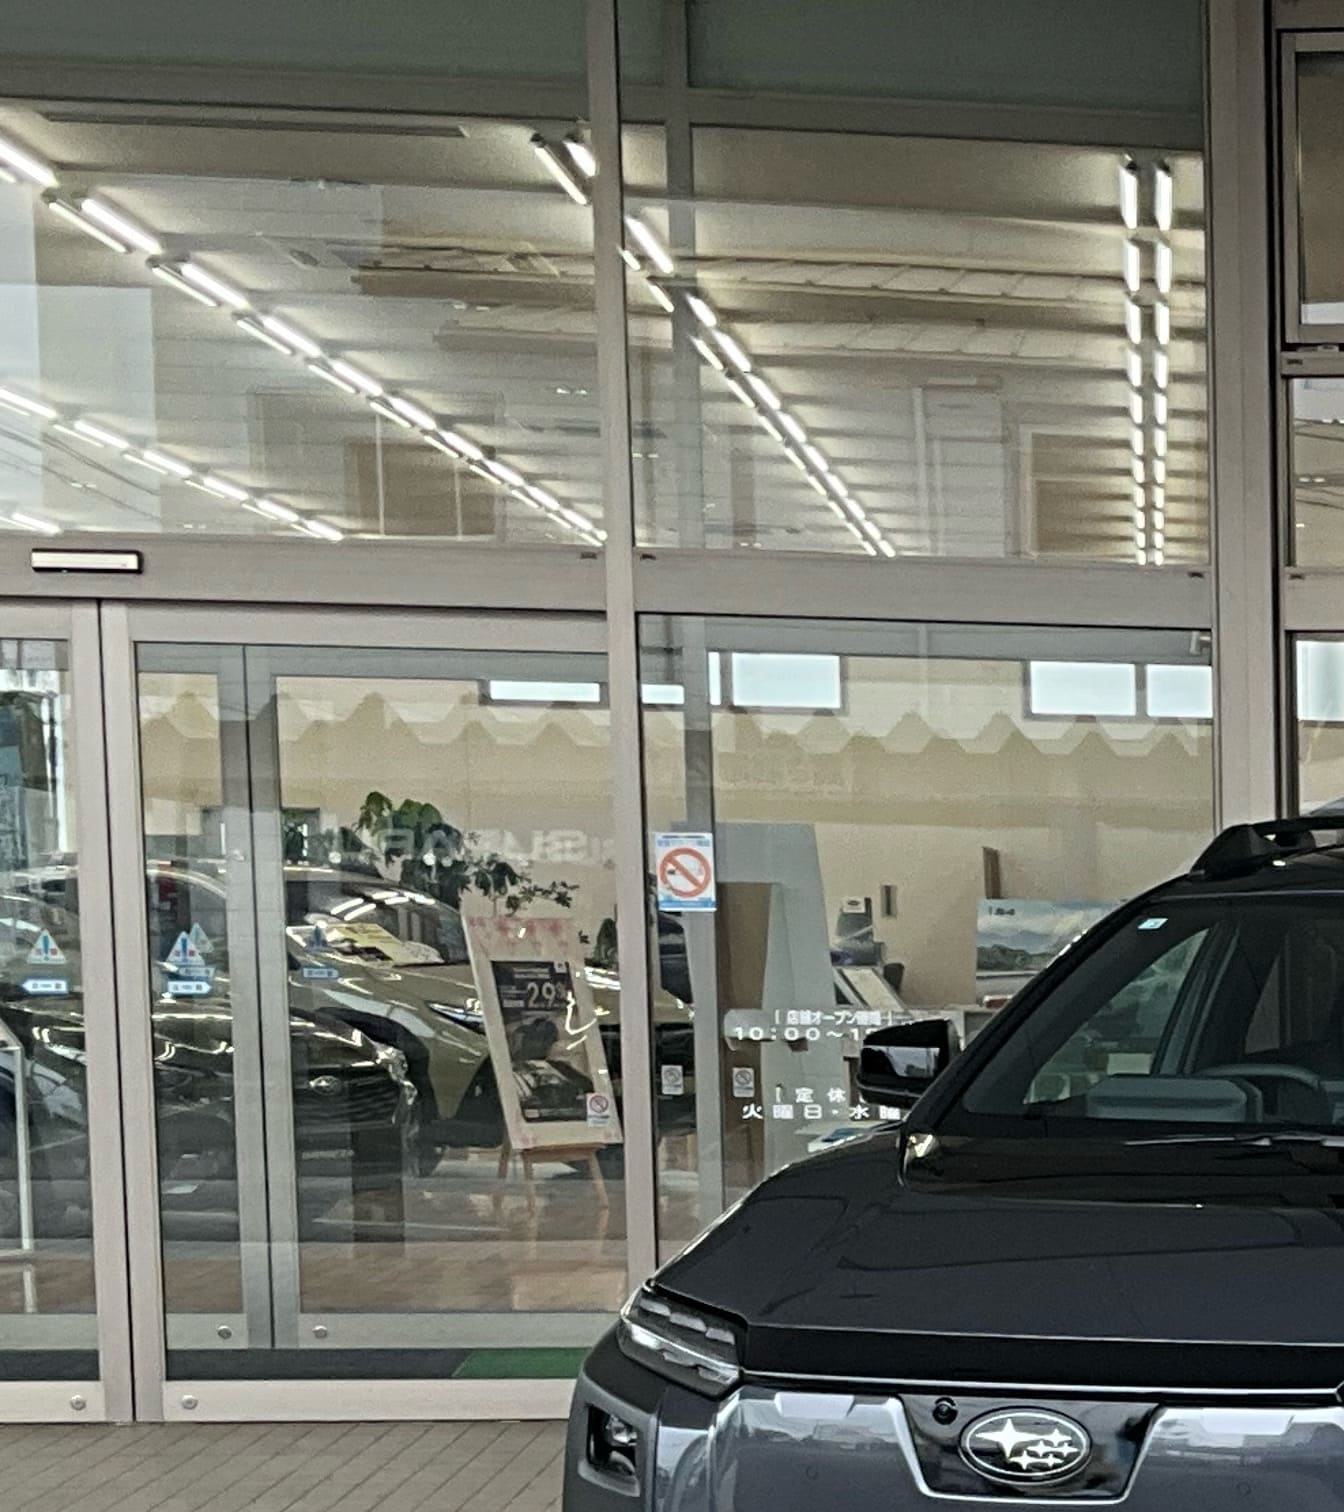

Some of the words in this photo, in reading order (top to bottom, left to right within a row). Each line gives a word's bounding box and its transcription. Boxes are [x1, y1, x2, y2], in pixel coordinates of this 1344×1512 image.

[742, 1103, 903, 1120] 火曜日・水曜
